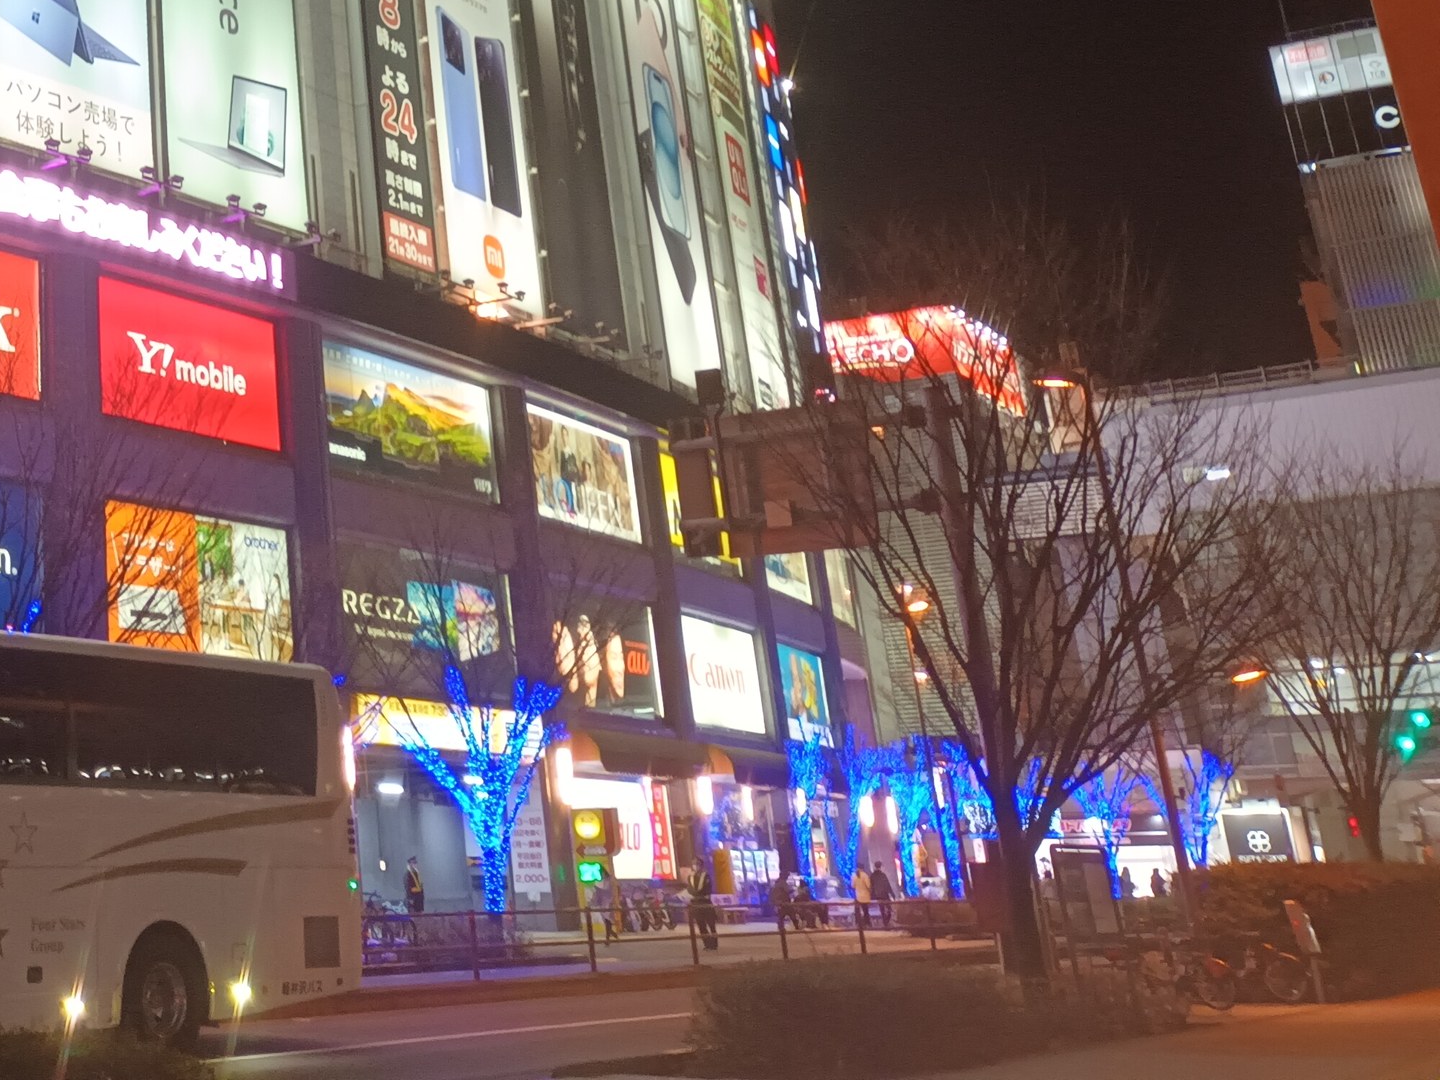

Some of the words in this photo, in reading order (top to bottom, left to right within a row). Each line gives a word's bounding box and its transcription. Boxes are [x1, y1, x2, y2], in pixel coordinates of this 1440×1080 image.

[375, 24, 408, 59] 時から
[381, 64, 410, 94] よる
[5, 78, 136, 138] パソコン売場で
[379, 87, 418, 145] 24
[385, 136, 417, 171] 時まで
[175, 357, 248, 397] mobile
[328, 441, 367, 462] anasonic
[243, 534, 281, 552] brother
[341, 587, 422, 625] REGZA
[626, 649, 650, 677] au
[689, 651, 747, 696] Canon
